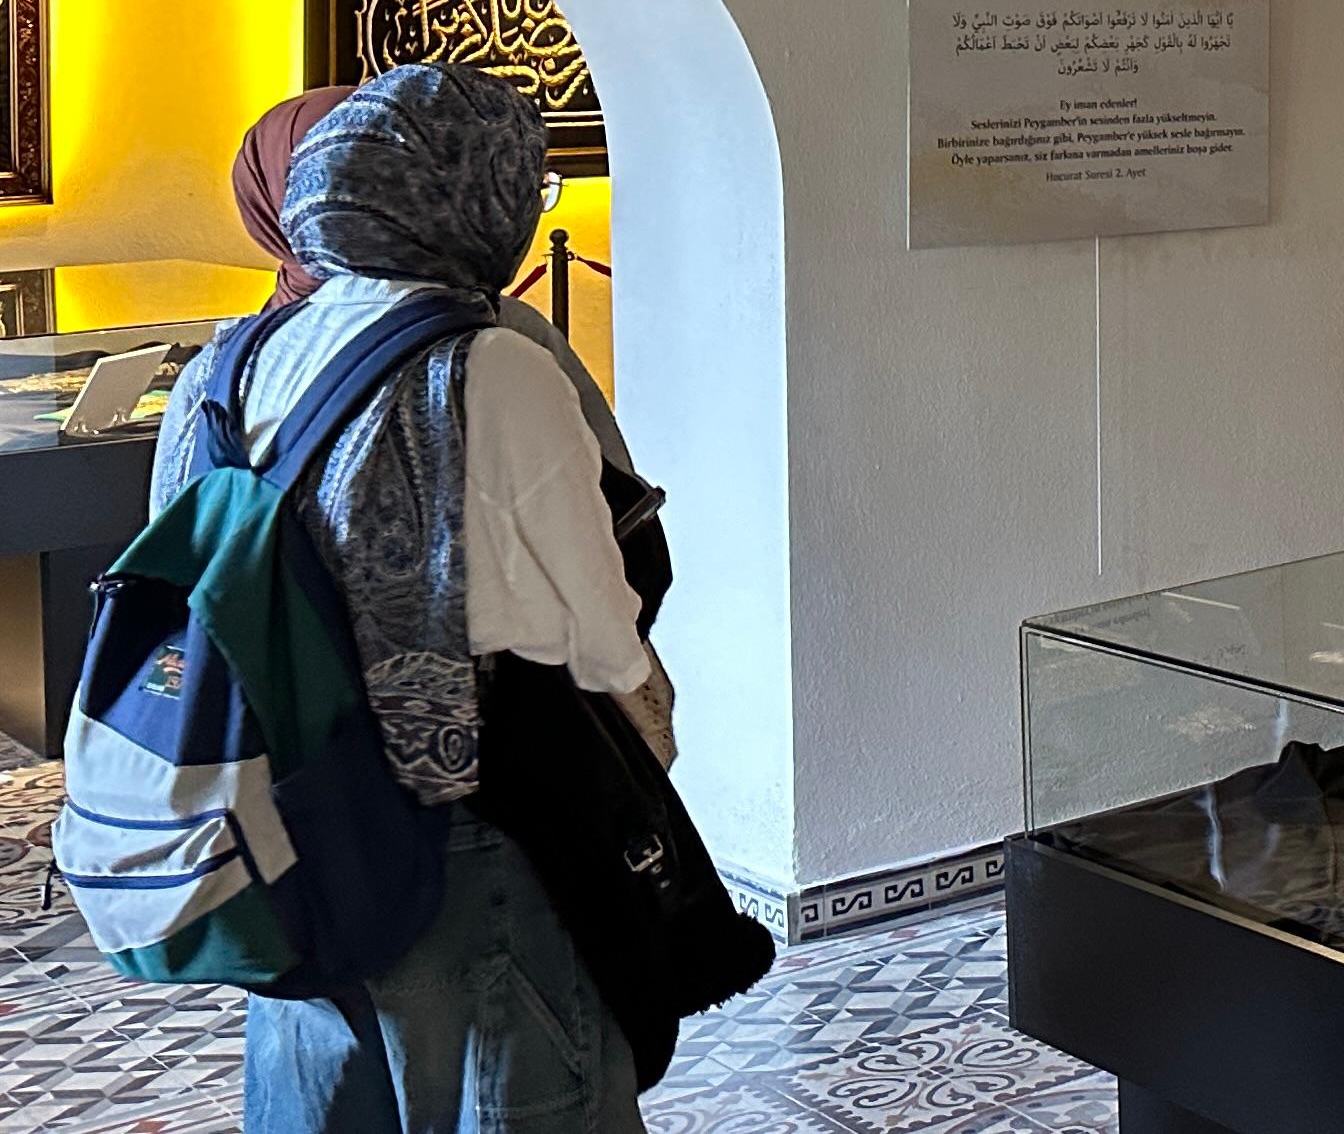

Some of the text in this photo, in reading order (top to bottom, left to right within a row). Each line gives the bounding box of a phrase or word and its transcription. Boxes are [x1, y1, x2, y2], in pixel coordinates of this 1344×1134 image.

[1060, 98, 1138, 112] Ey iman edenler!
[971, 118, 1022, 130] Seslerinizi
[1090, 115, 1130, 125] sesinden
[1132, 113, 1154, 124] fazla
[1156, 112, 1217, 125] yükseltmeyin.
[938, 136, 990, 149] Birbirinize
[993, 134, 1050, 147] bağırdığınız
[1137, 129, 1168, 142] yüksek
[1171, 128, 1192, 139] sesle
[1194, 127, 1246, 139] bağırmayın.
[951, 152, 974, 166] Öyle
[1034, 151, 1048, 161] siz
[1050, 149, 1083, 162] farkına
[1086, 147, 1132, 159] varmadan
[1134, 145, 1185, 157] amelleriniz
[1187, 144, 1207, 155] boşa
[1115, 169, 1124, 178] 2.
[1126, 168, 1146, 180] Ayet
